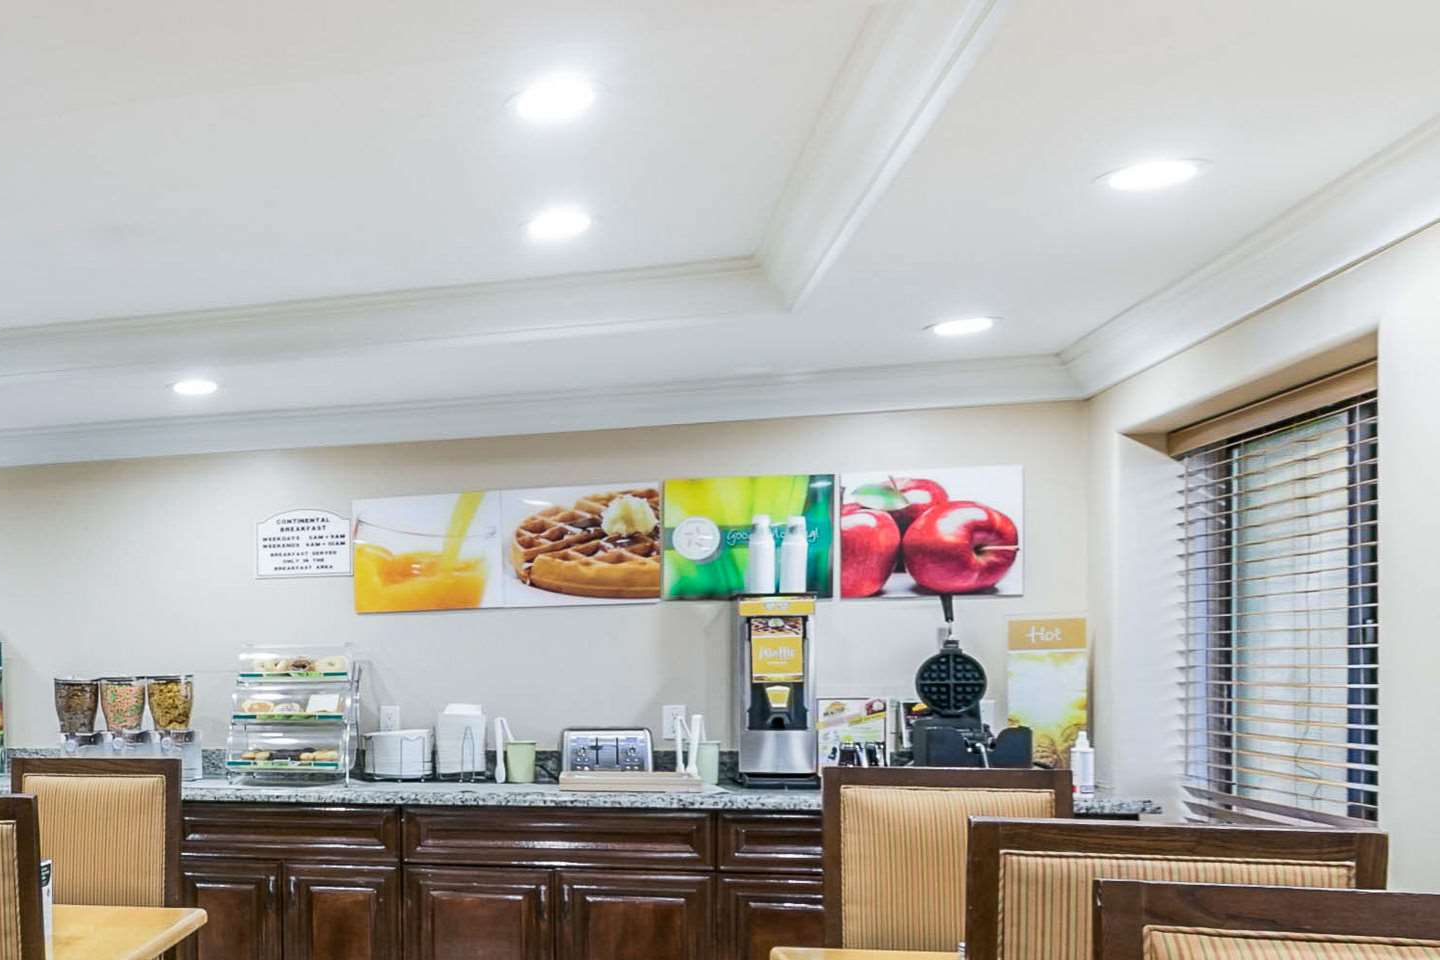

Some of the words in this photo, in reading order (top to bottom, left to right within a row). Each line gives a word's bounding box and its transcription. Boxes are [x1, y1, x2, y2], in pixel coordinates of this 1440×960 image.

[276, 517, 331, 525] CONTINENTAL
[280, 525, 326, 533] BREAKFAST
[1026, 625, 1062, 643] Hot
